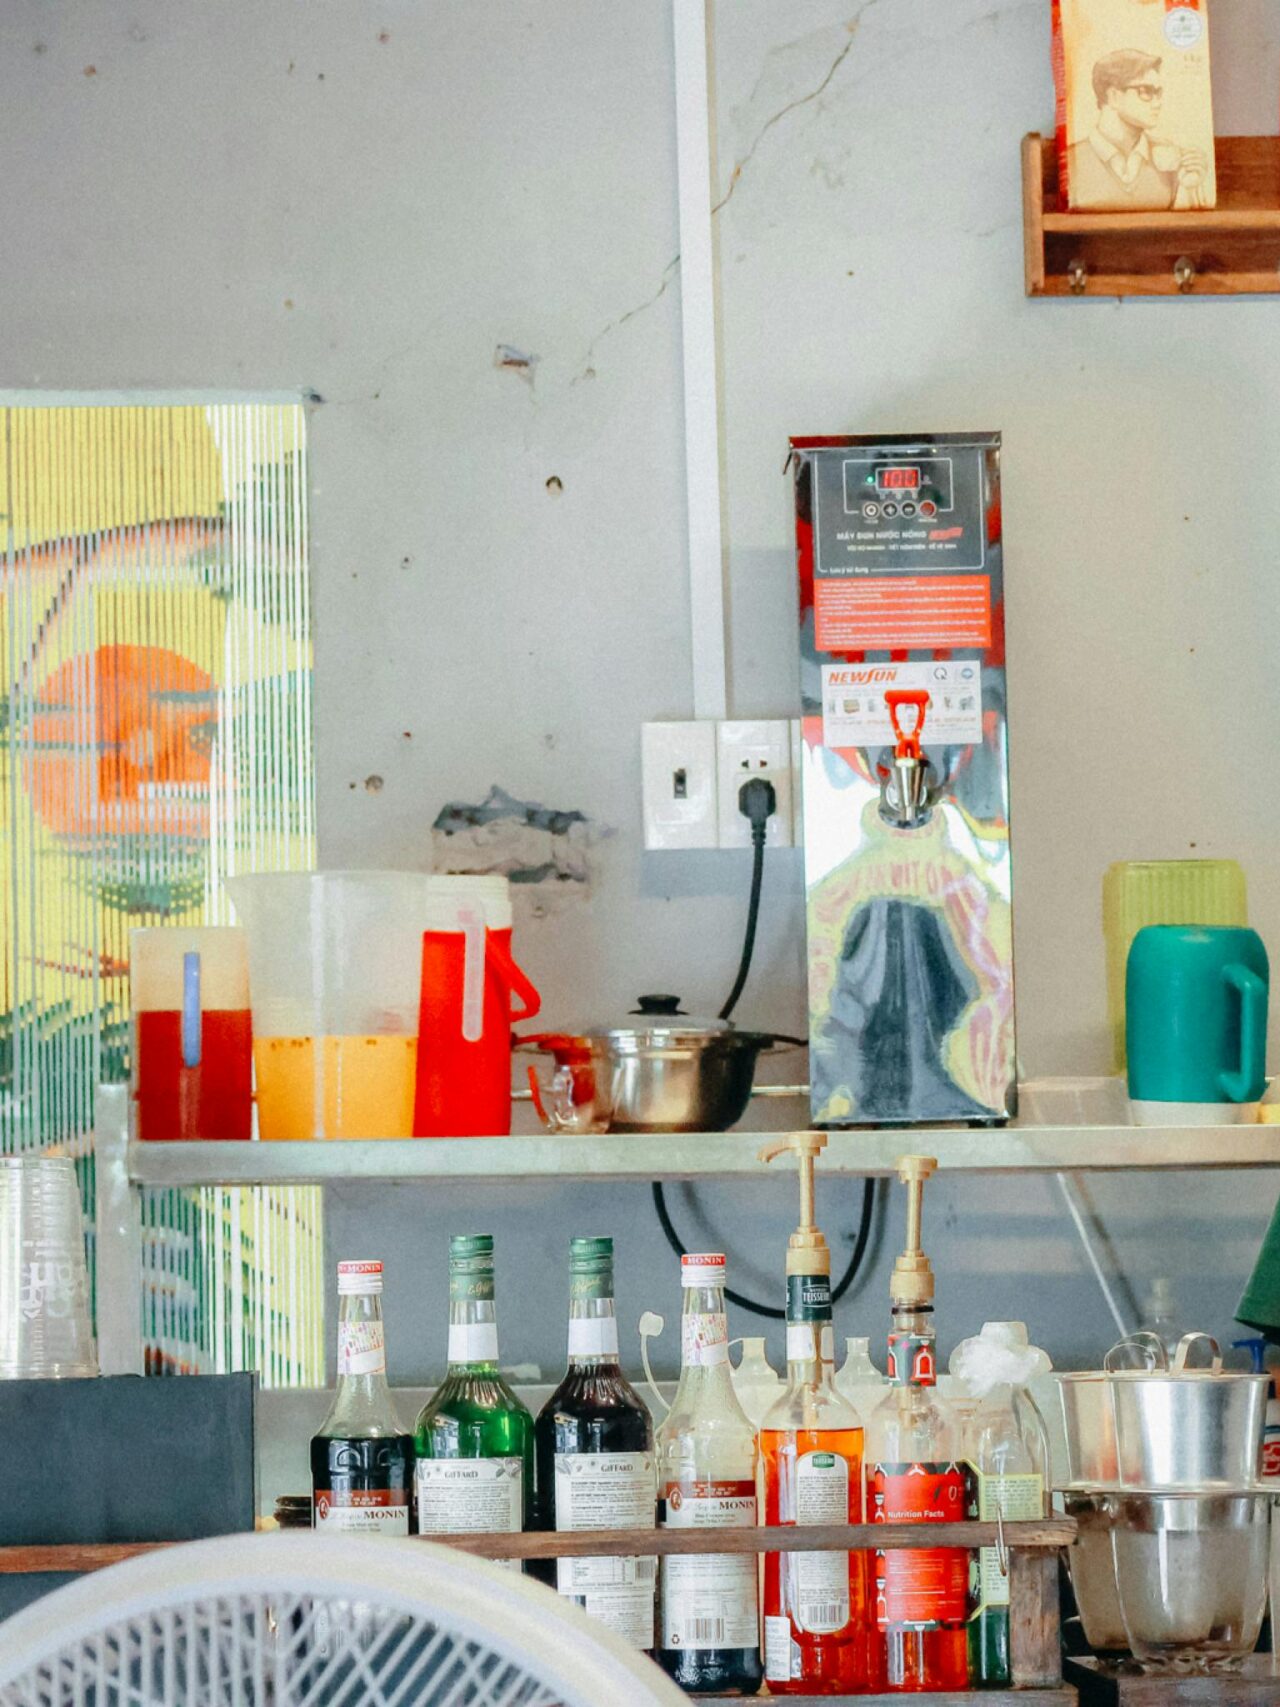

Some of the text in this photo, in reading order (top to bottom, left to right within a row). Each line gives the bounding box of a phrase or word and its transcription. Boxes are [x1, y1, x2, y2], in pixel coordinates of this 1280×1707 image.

[883, 469, 918, 487] 100
[687, 1255, 722, 1264] MONIN
[348, 1263, 381, 1273] MONIN
[719, 1500, 754, 1510] MONIN
[364, 1510, 405, 1519] MONIN
[923, 1510, 944, 1518] Facts
